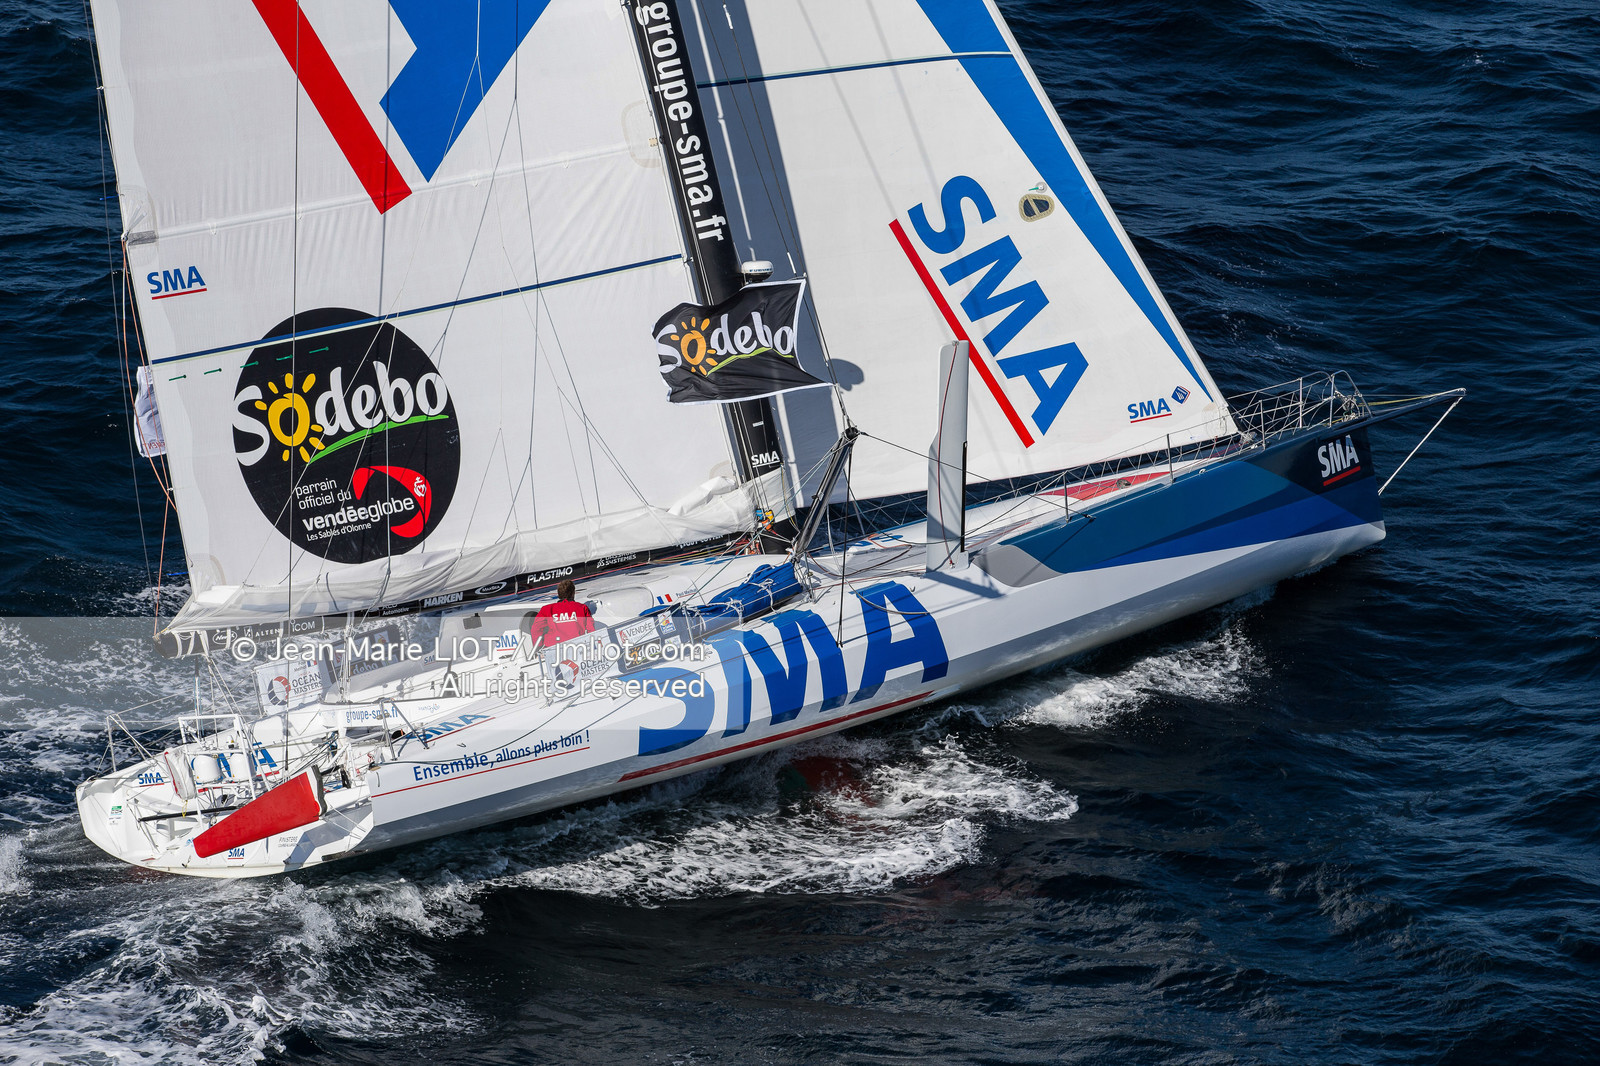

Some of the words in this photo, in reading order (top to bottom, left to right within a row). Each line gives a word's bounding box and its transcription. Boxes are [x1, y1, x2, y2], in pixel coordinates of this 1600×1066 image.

[635, 1, 727, 242] groupe-sma.fr
[146, 265, 207, 295] SMA
[906, 175, 1090, 437] SMA
[654, 310, 796, 374] Sodebo
[231, 360, 449, 467] Sodebo
[1127, 398, 1172, 420] SMA
[751, 451, 780, 467] SMA
[1317, 434, 1360, 479] SMA
[295, 478, 338, 499] parrain
[299, 491, 335, 510] officiel
[336, 489, 352, 502] du
[306, 533, 319, 542] Les
[318, 528, 341, 540] Sables
[340, 522, 372, 535] d'Olonne
[527, 567, 573, 584] PLASTIMO
[424, 592, 463, 609] HARKEN
[552, 611, 578, 622] SMA
[255, 628, 280, 638] ALTEN
[627, 622, 652, 637] VENDÉE
[581, 662, 610, 678] MASTERS
[613, 580, 949, 757] SMA
[292, 671, 322, 688] OCEAN
[293, 681, 323, 696] MASTERS
[413, 752, 494, 781] Ensemble,
[496, 746, 531, 762] allons
[534, 739, 558, 758] plus
[560, 733, 583, 748] loin
[138, 771, 165, 785] SMA
[228, 848, 245, 858] SMA
